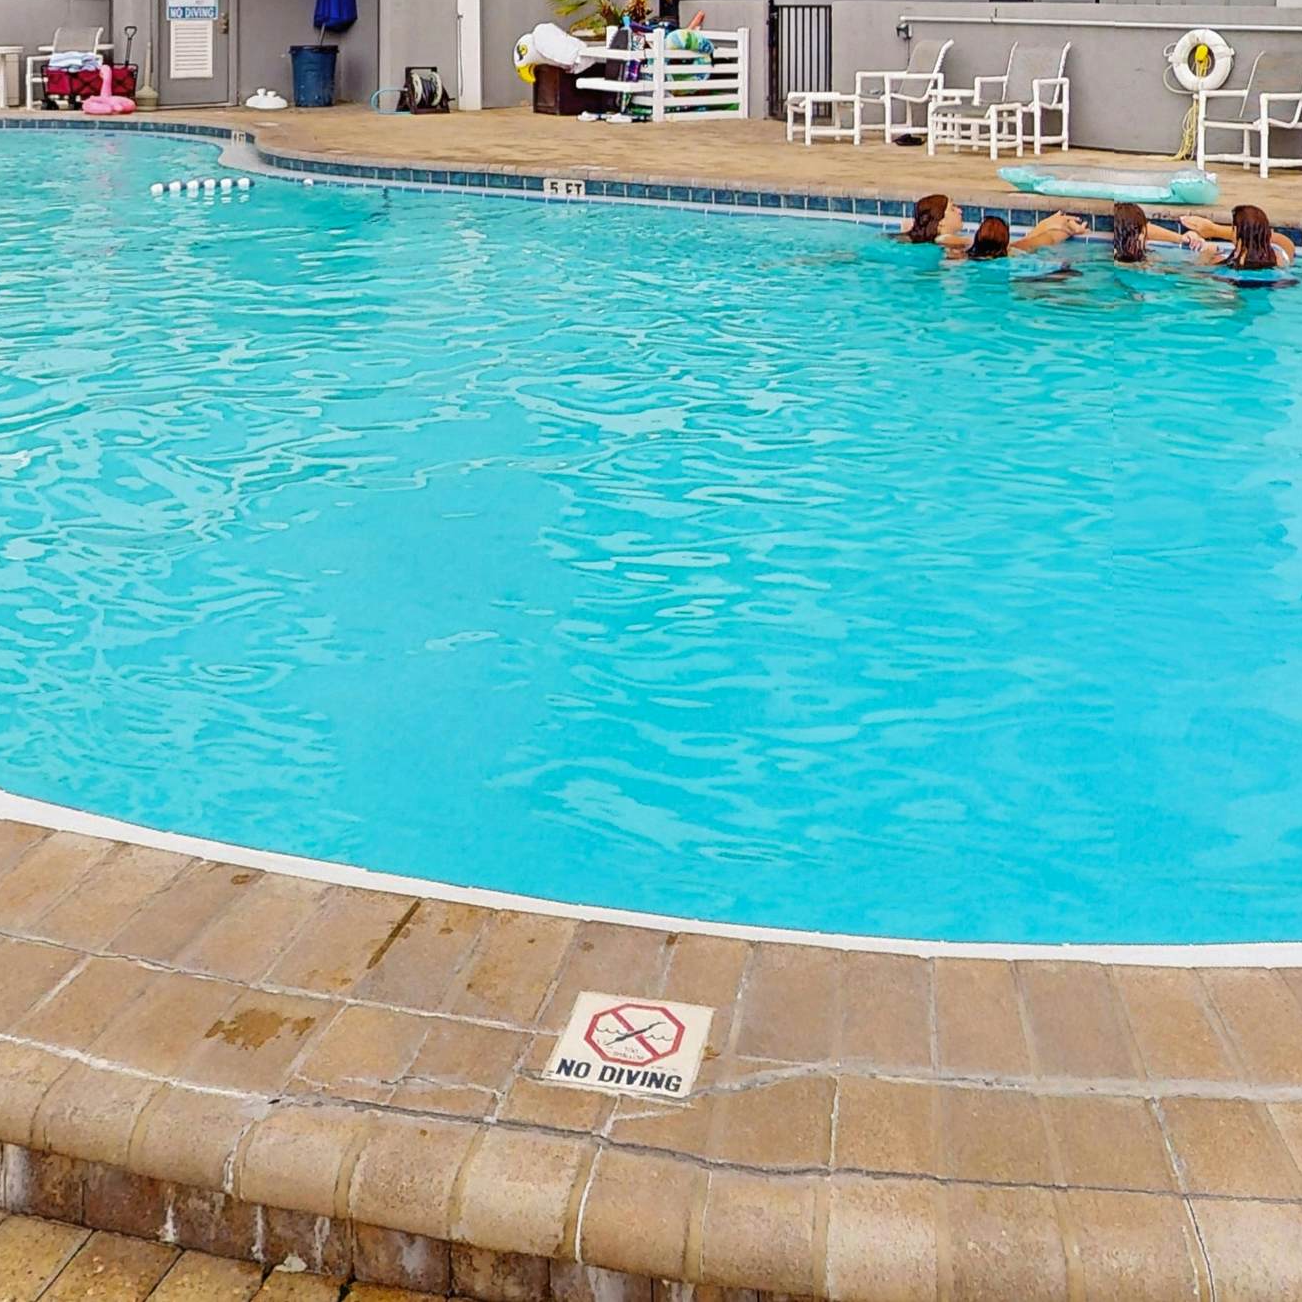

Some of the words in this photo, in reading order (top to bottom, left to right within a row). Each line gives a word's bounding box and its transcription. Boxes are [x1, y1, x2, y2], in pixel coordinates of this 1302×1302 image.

[170, 8, 183, 17] NO
[185, 8, 214, 17] DIVING
[550, 182, 558, 194] 5
[555, 1057, 591, 1079] NO
[598, 1065, 683, 1093] DIVING
